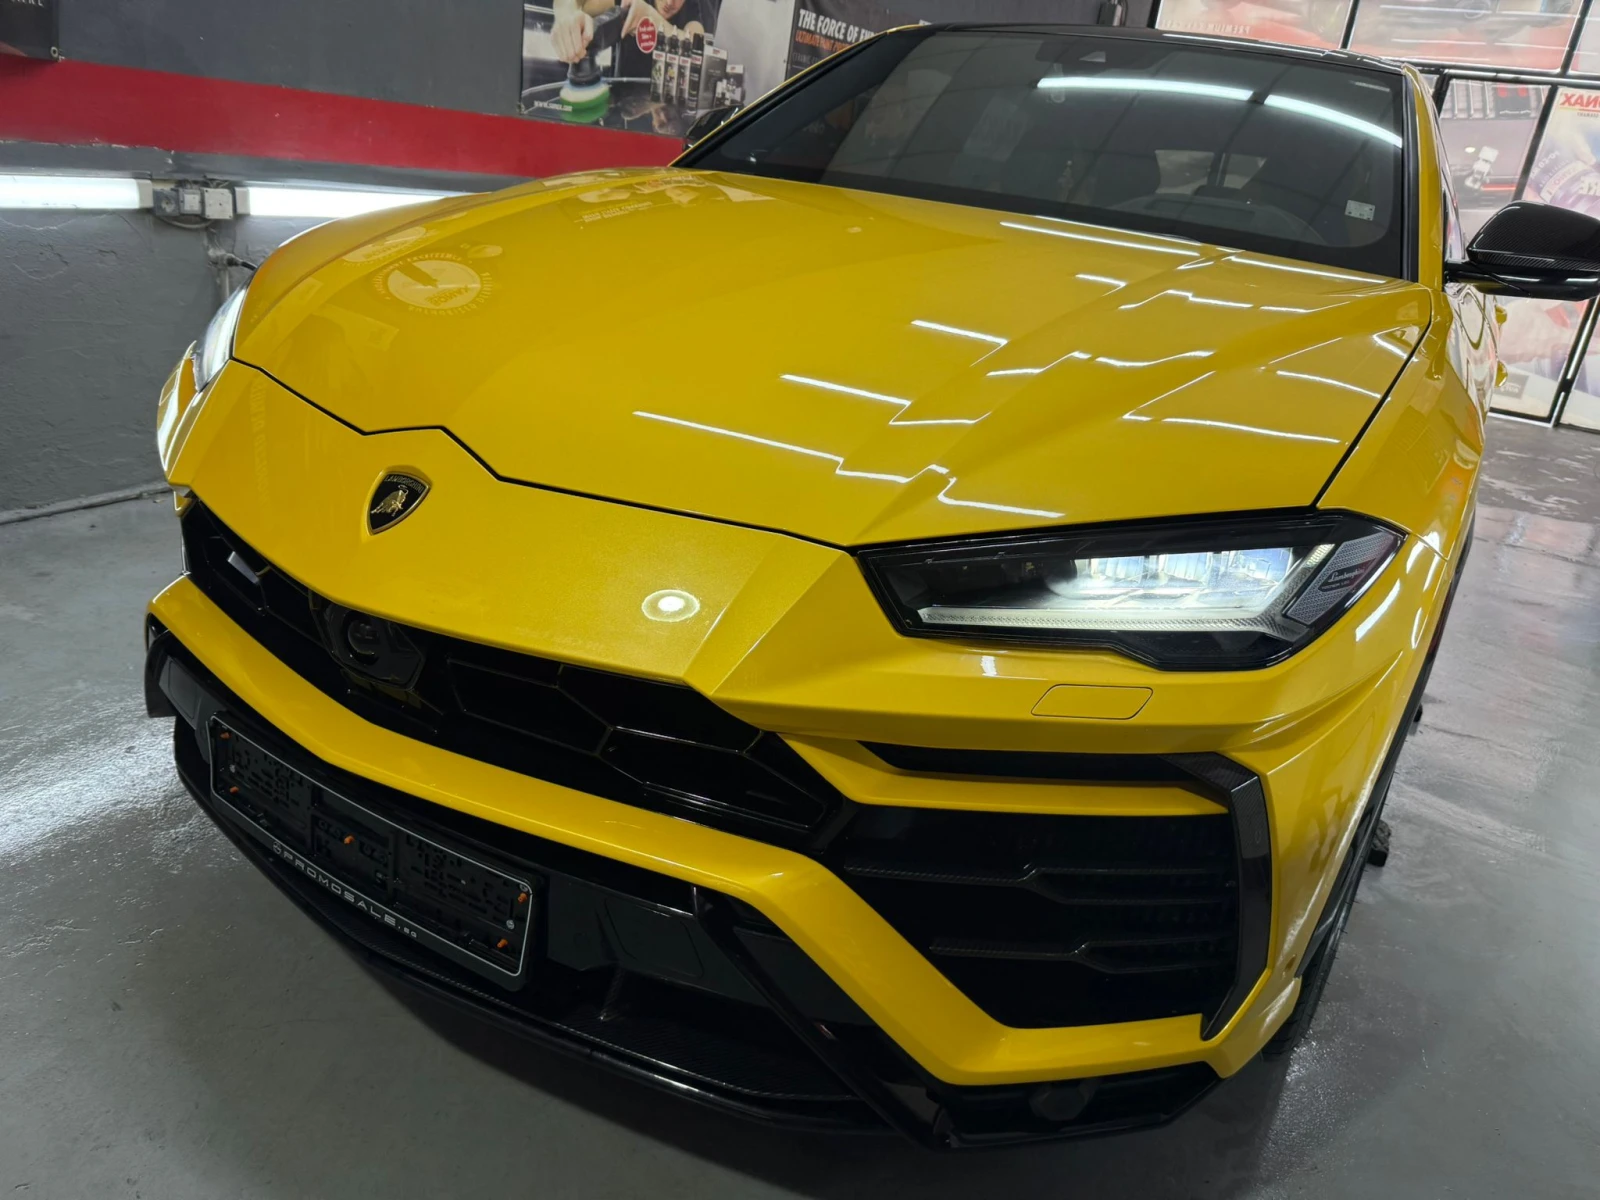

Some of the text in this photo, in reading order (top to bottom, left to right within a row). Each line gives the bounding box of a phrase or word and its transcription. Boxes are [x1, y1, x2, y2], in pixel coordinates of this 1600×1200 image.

[798, 8, 817, 31] THE
[817, 15, 847, 40] FORCE
[846, 25, 860, 43] OF
